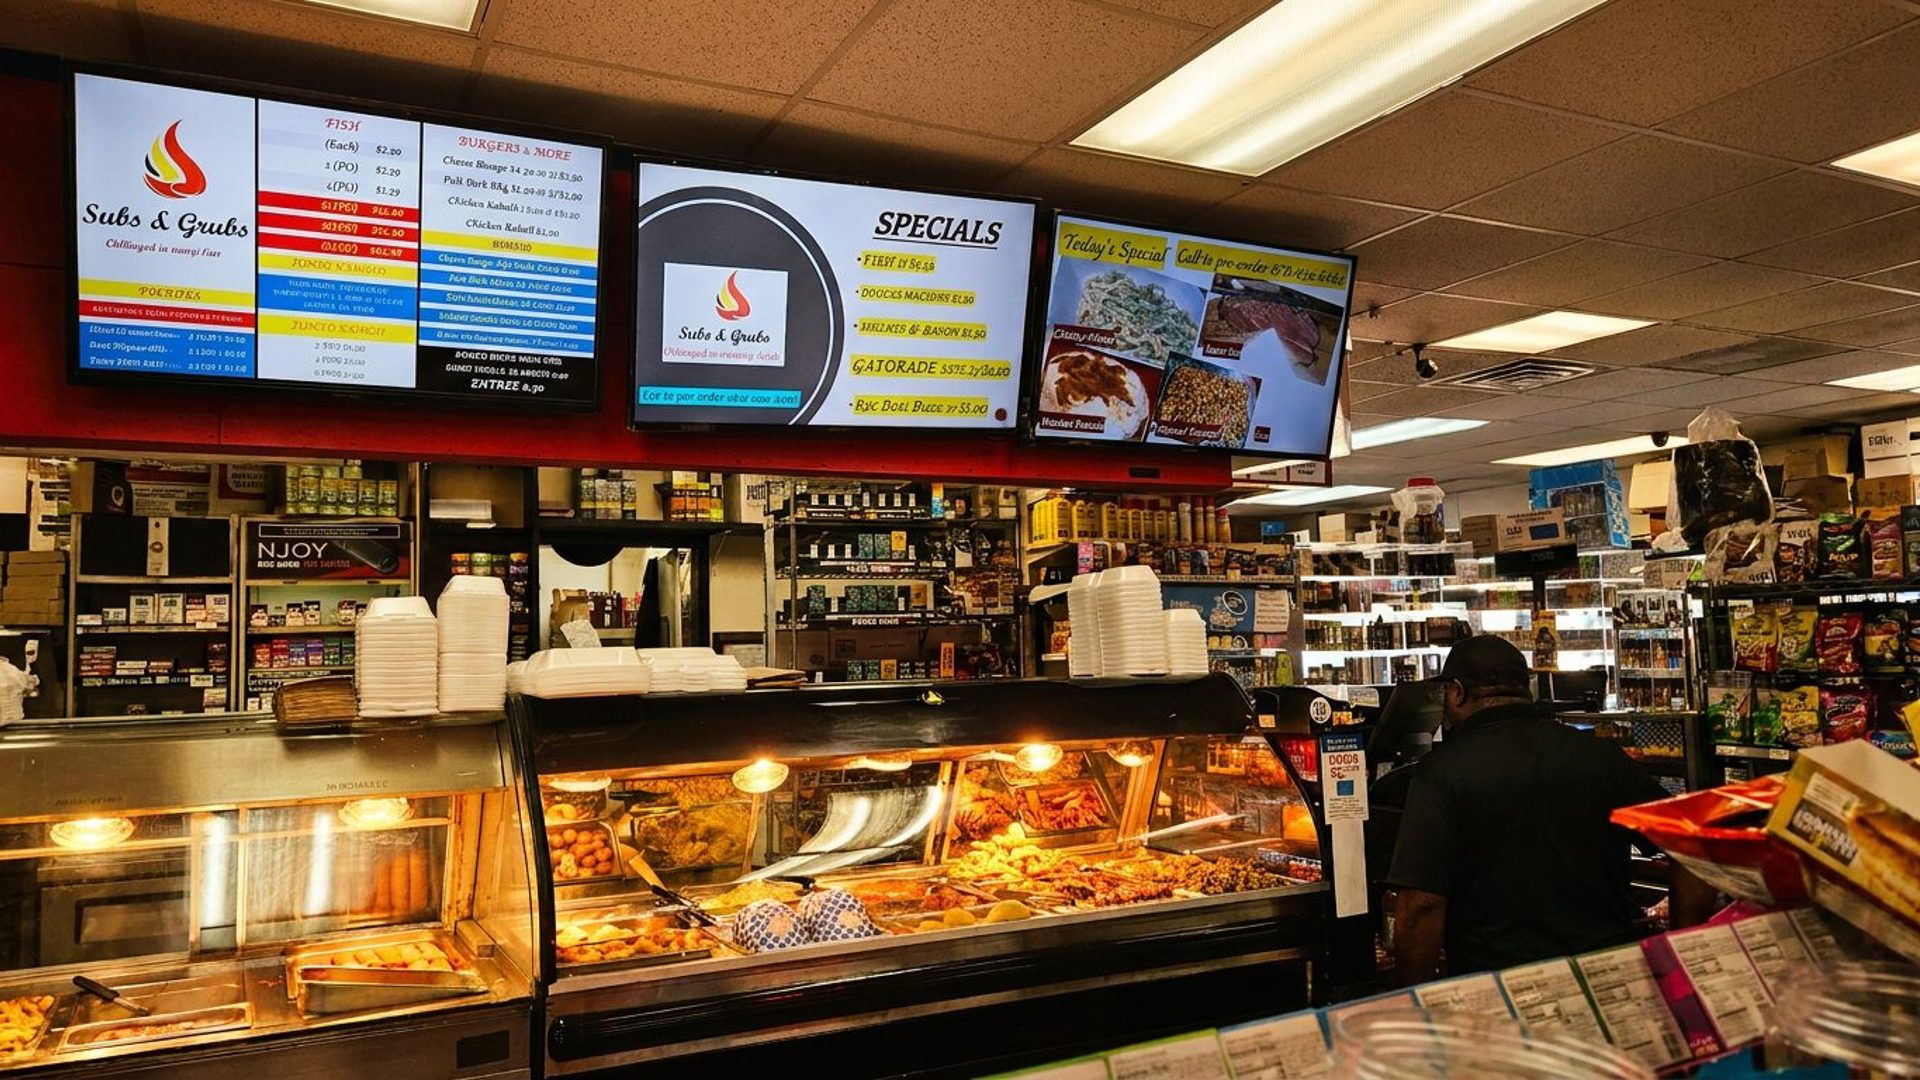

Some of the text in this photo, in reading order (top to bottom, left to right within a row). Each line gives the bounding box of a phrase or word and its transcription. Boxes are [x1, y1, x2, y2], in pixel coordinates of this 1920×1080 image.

[83, 203, 249, 239] Subs & Grubs
[874, 211, 1003, 245] SPECIALS
[853, 358, 937, 375] GATORADE
[258, 542, 328, 559] NJOY
